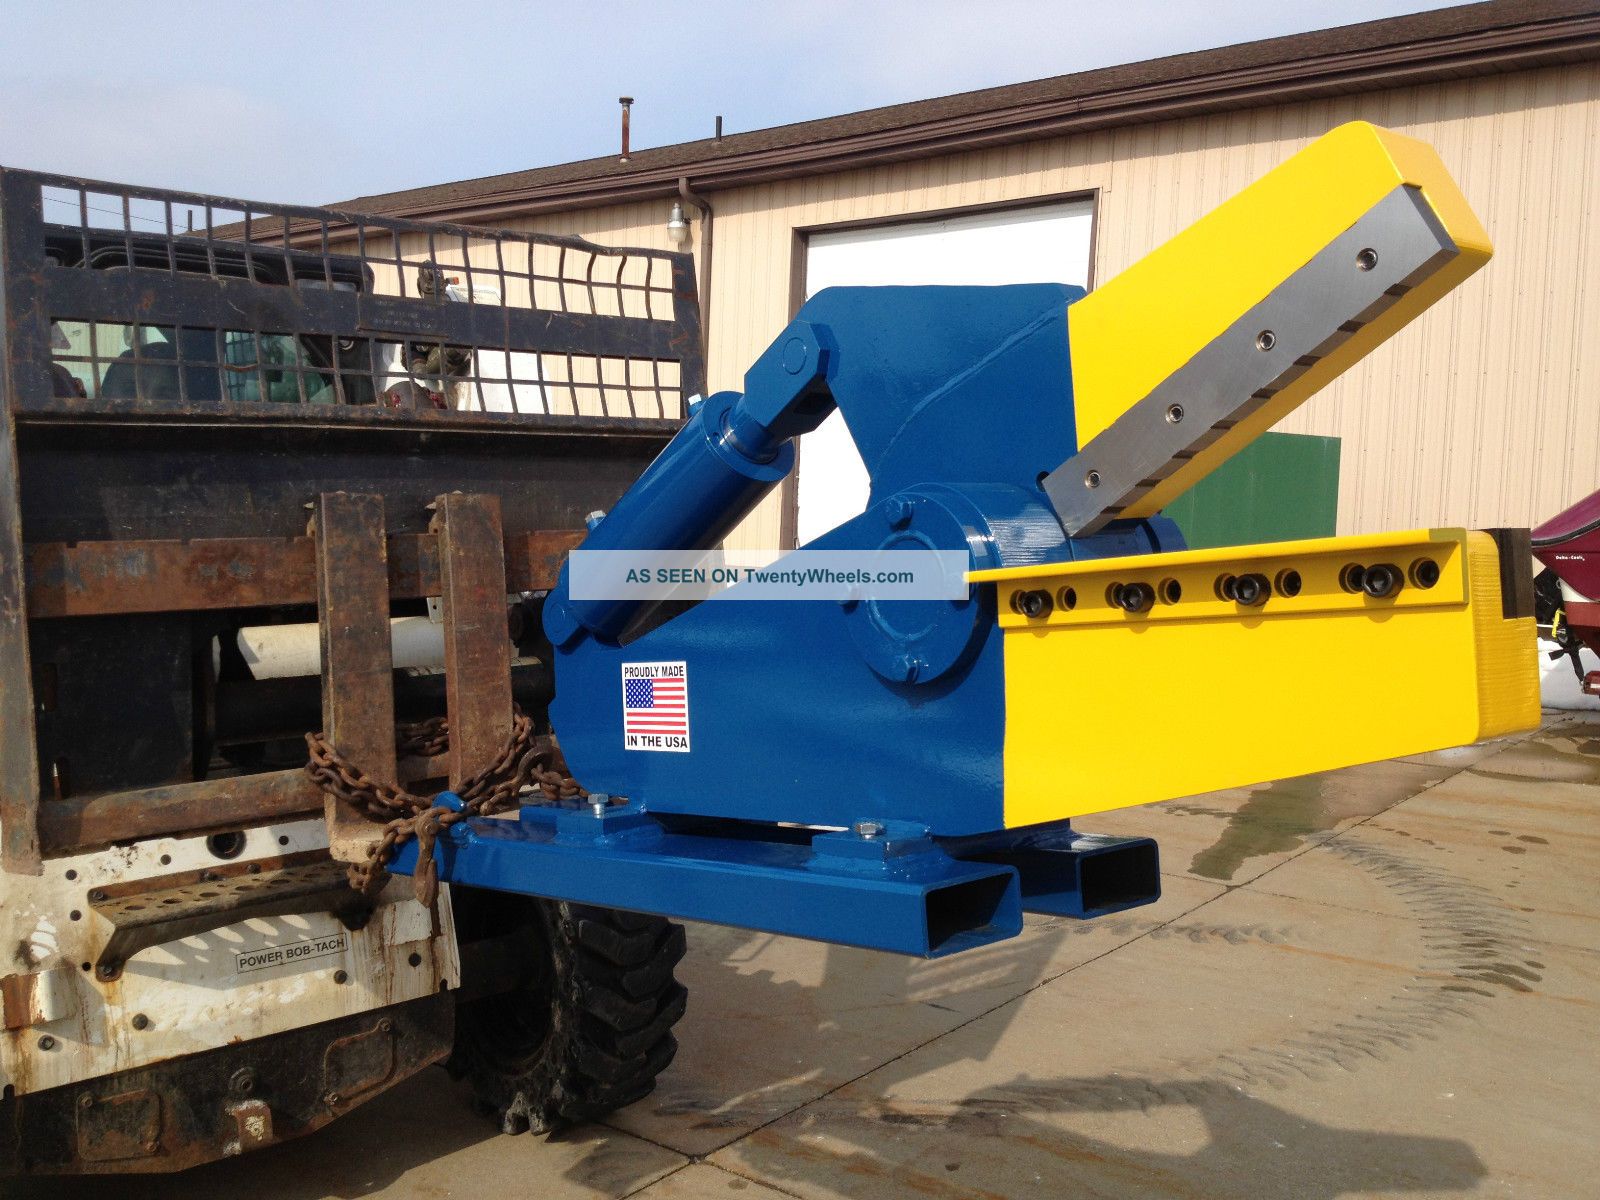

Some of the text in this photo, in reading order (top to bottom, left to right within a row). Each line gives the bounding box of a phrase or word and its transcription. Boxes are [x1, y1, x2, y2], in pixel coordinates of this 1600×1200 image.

[624, 666, 684, 677] PROUDLY MADE
[627, 735, 688, 748] IN THE USA
[239, 938, 345, 968] POWER BOB-TACH
